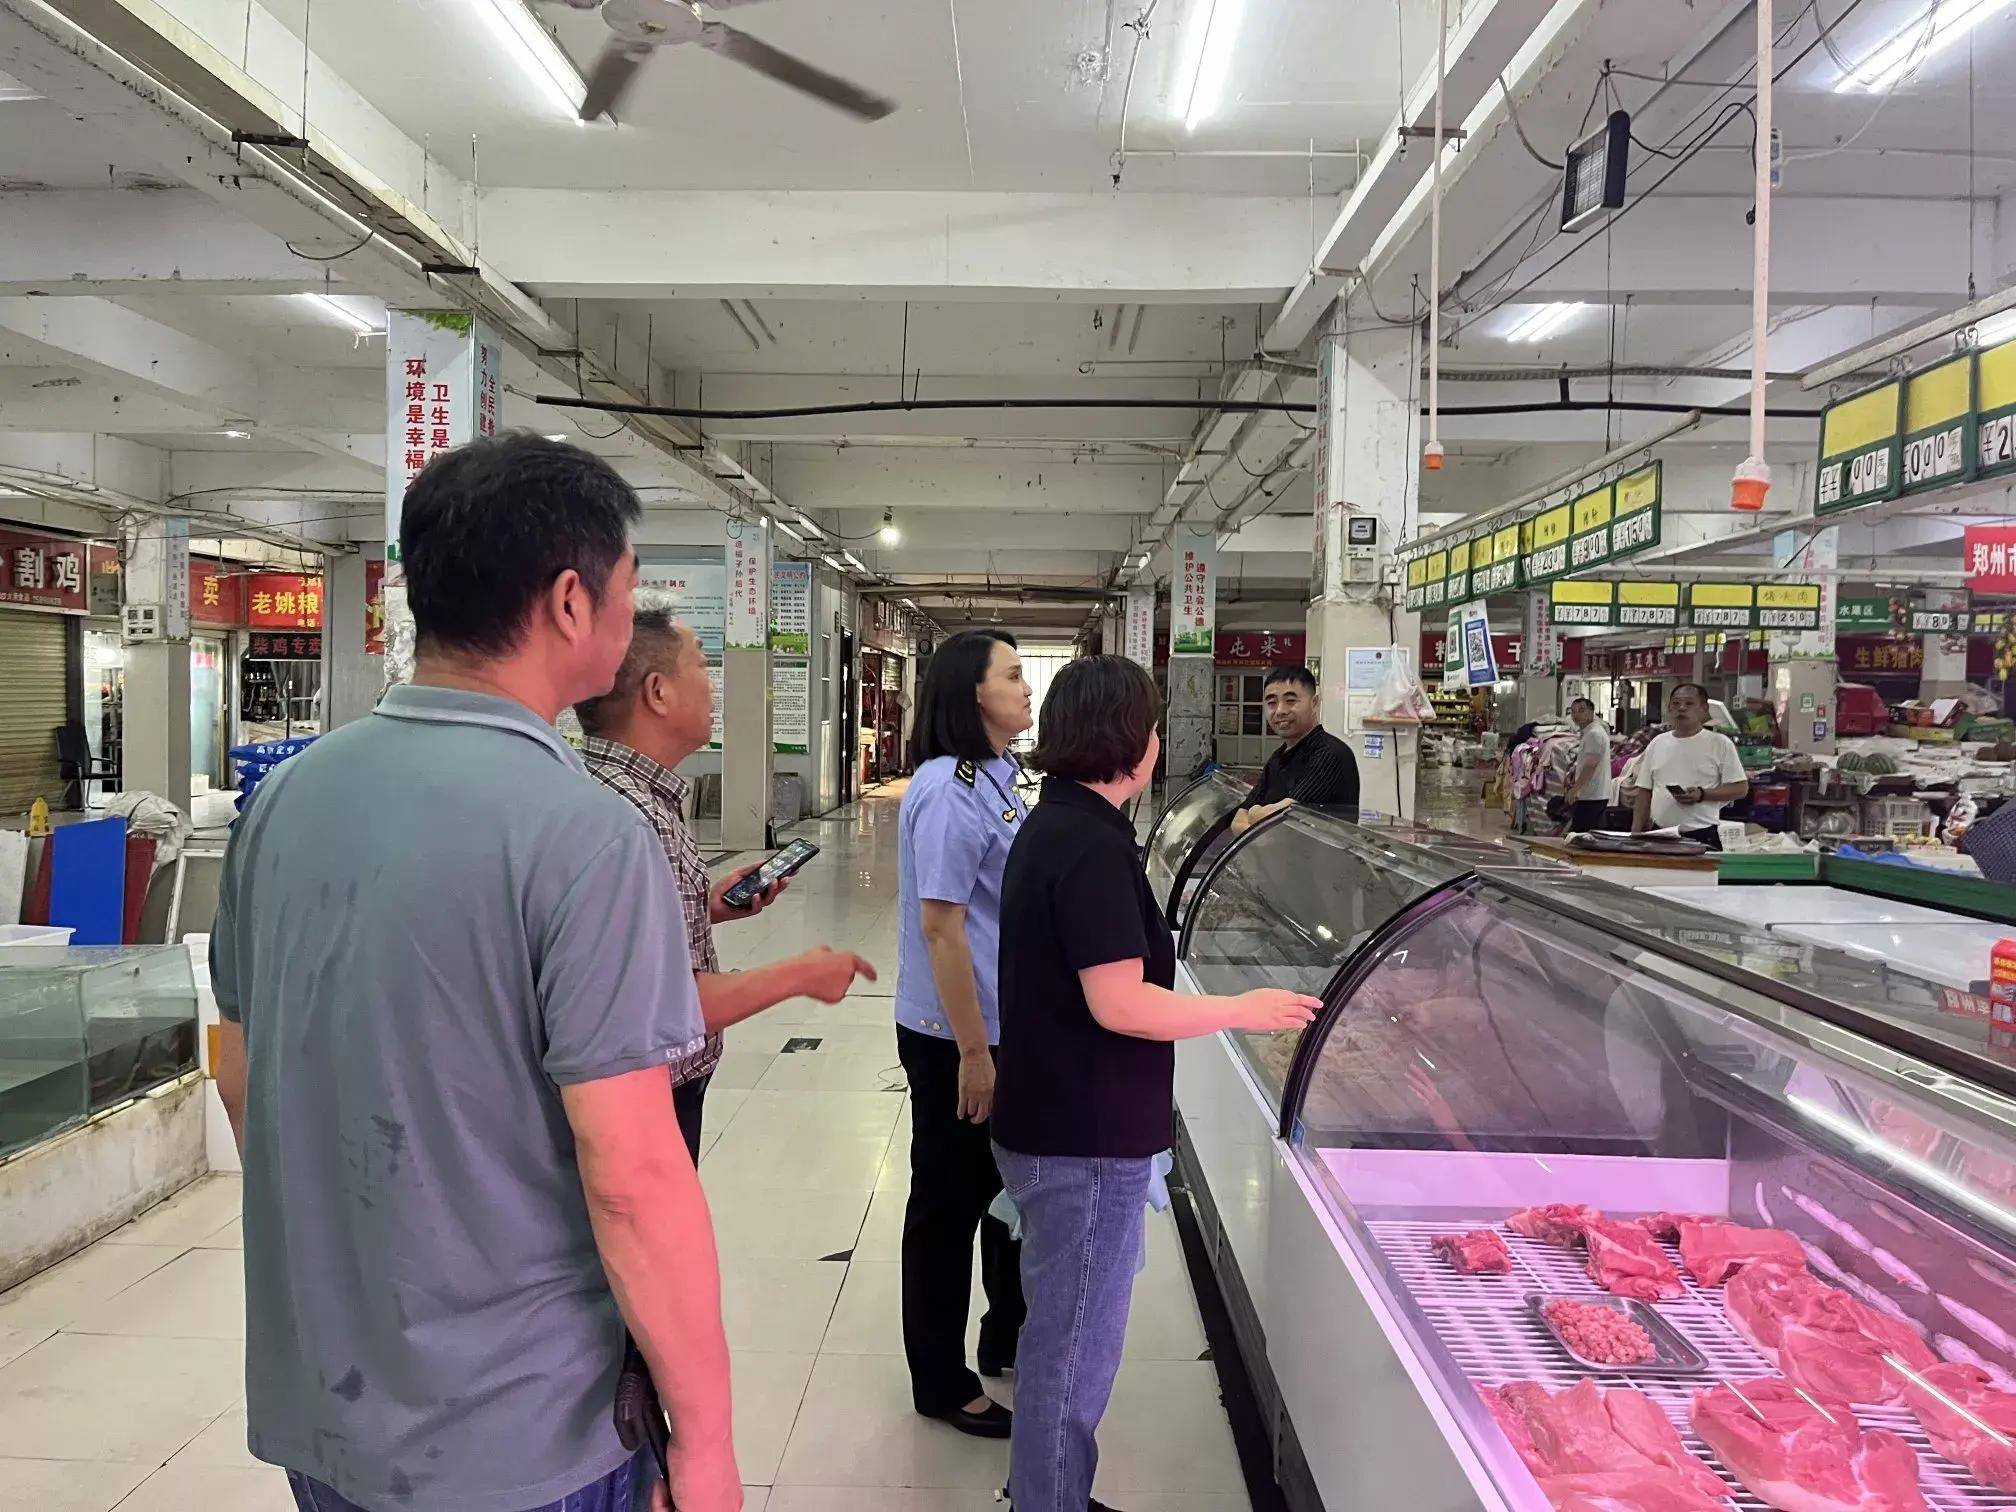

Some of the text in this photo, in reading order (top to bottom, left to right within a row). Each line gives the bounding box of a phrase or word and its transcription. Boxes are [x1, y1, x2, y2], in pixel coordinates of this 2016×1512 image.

[0, 547, 80, 594] 割鸡
[748, 557, 757, 615] 保护生态环境
[1183, 551, 1194, 615] 维护公共卫生
[252, 591, 319, 615] 老姚粮
[252, 634, 321, 656] 柴鸡专卖
